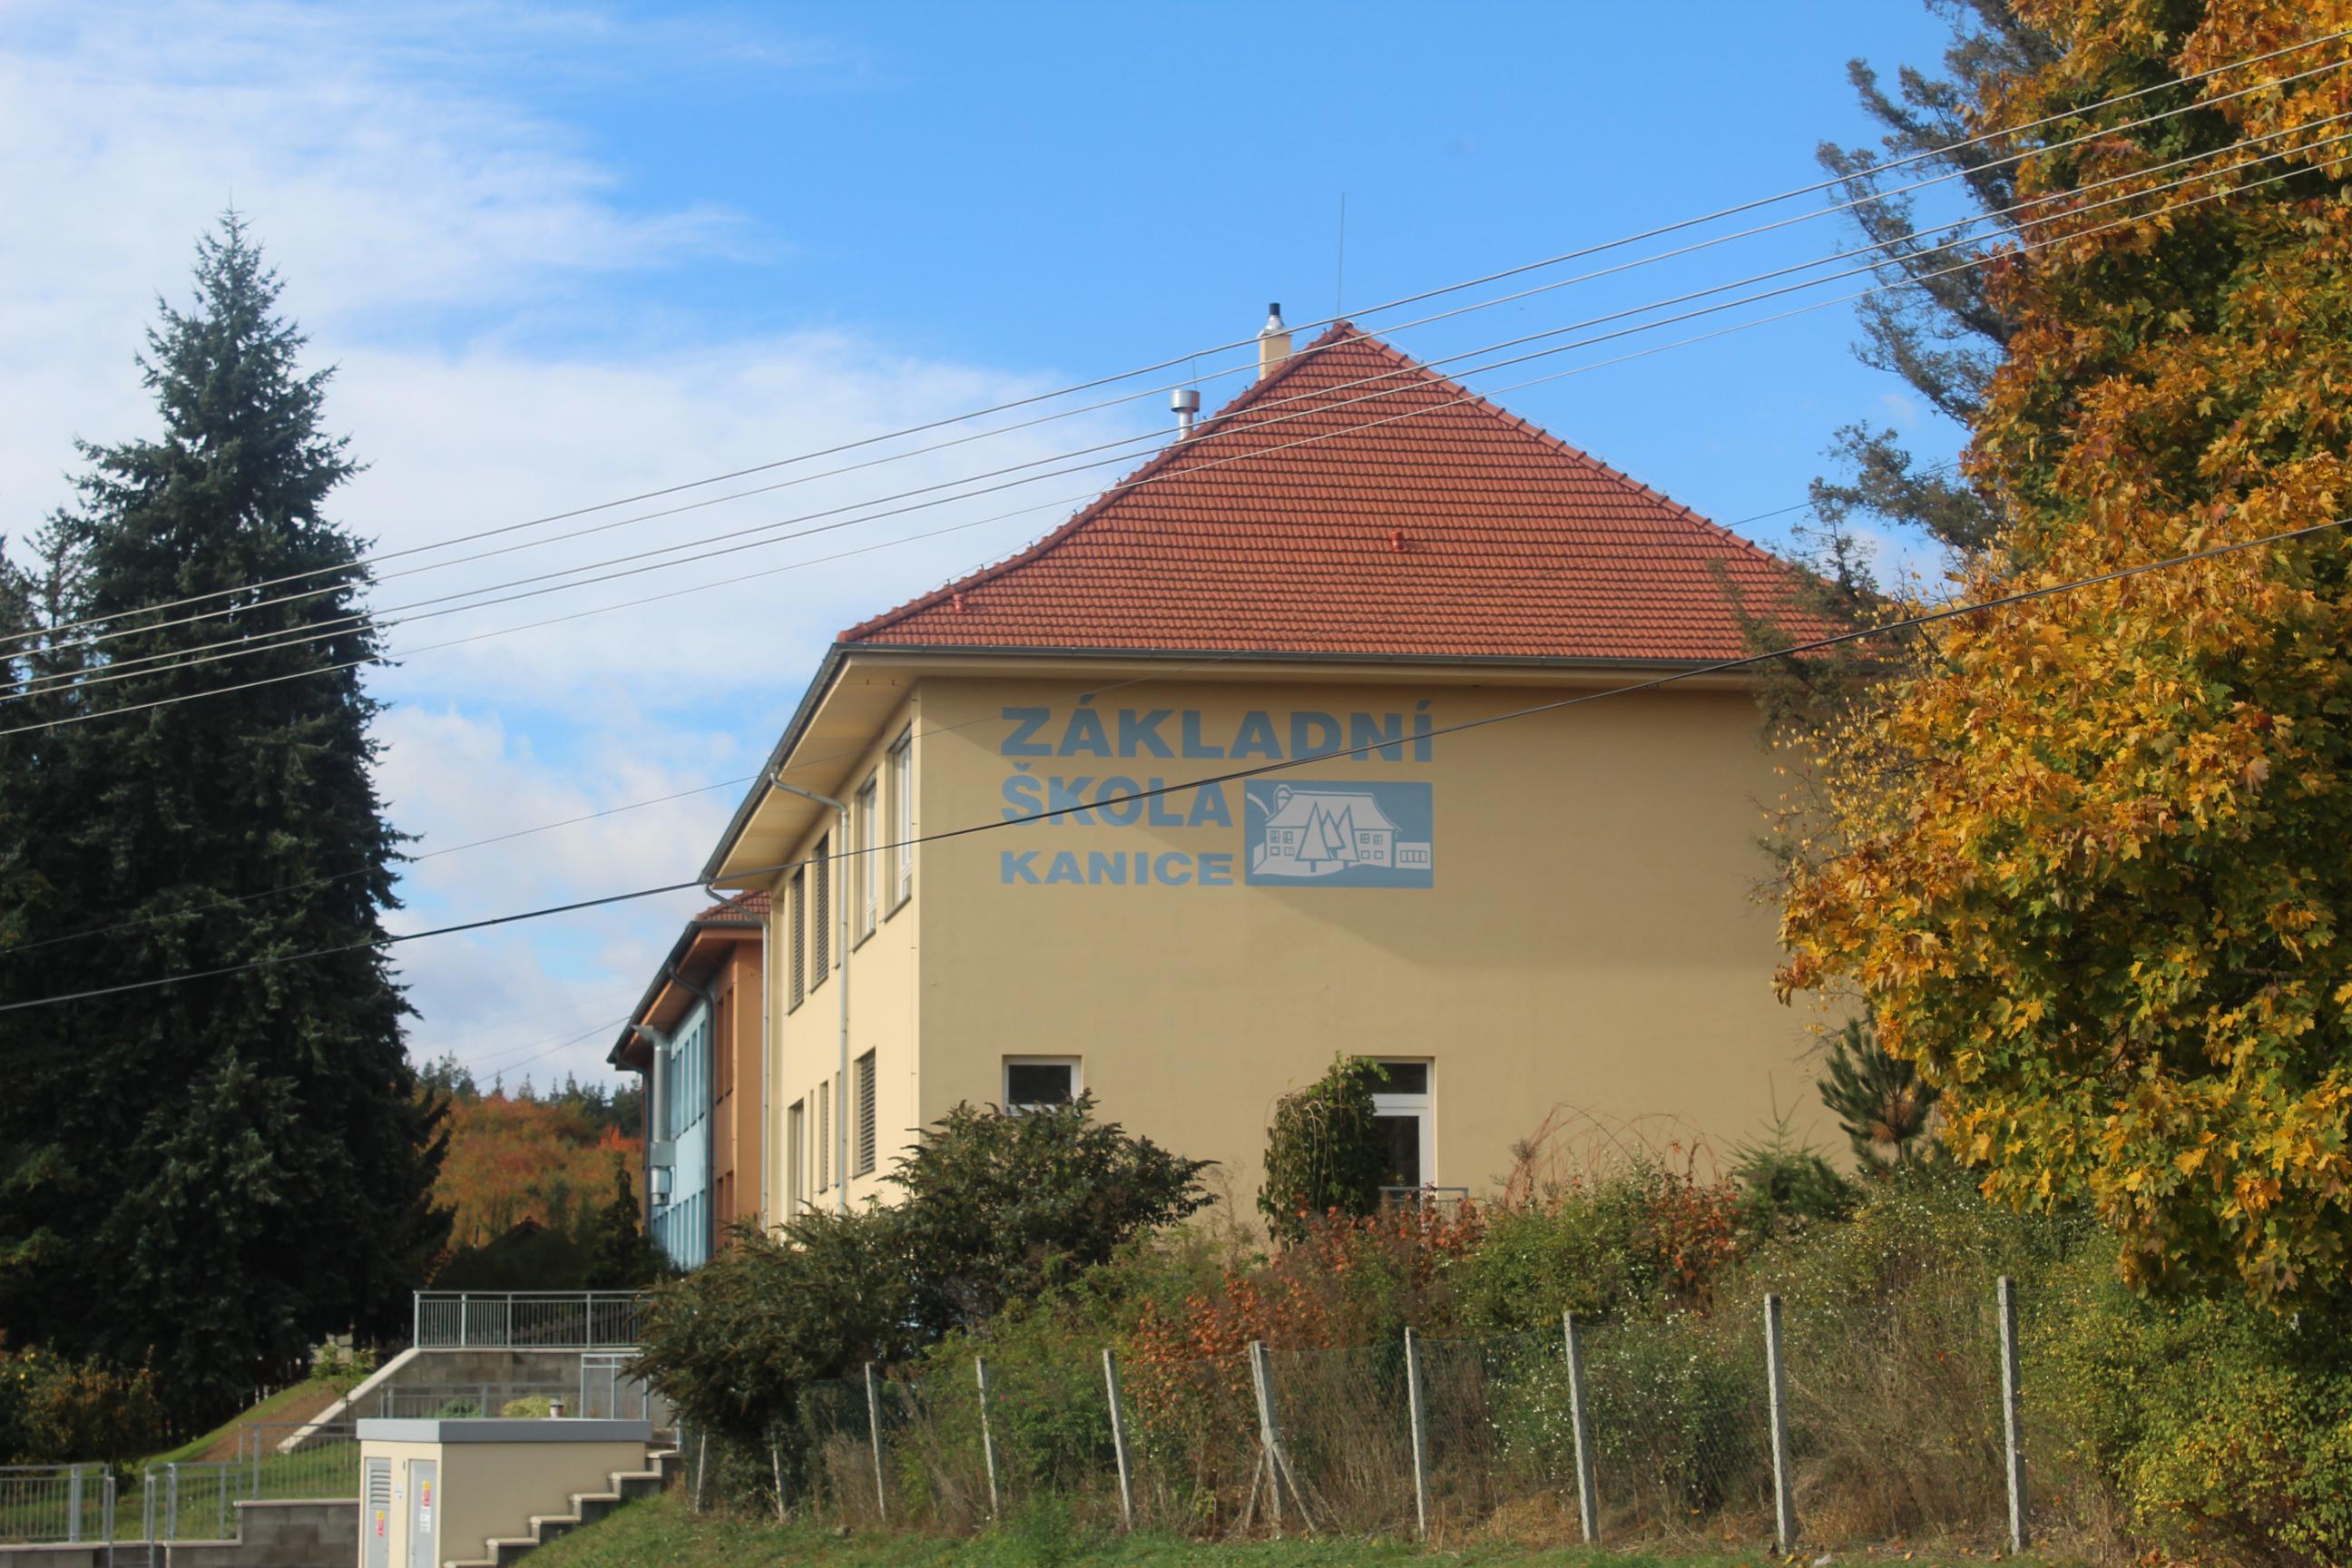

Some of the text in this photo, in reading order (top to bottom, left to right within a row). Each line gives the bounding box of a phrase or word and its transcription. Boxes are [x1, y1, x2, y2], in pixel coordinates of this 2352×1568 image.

[1001, 694, 1433, 762] ZÁKLADNÍ
[1001, 762, 1233, 828] ŠKOLA
[1001, 850, 1234, 887] KANICE
